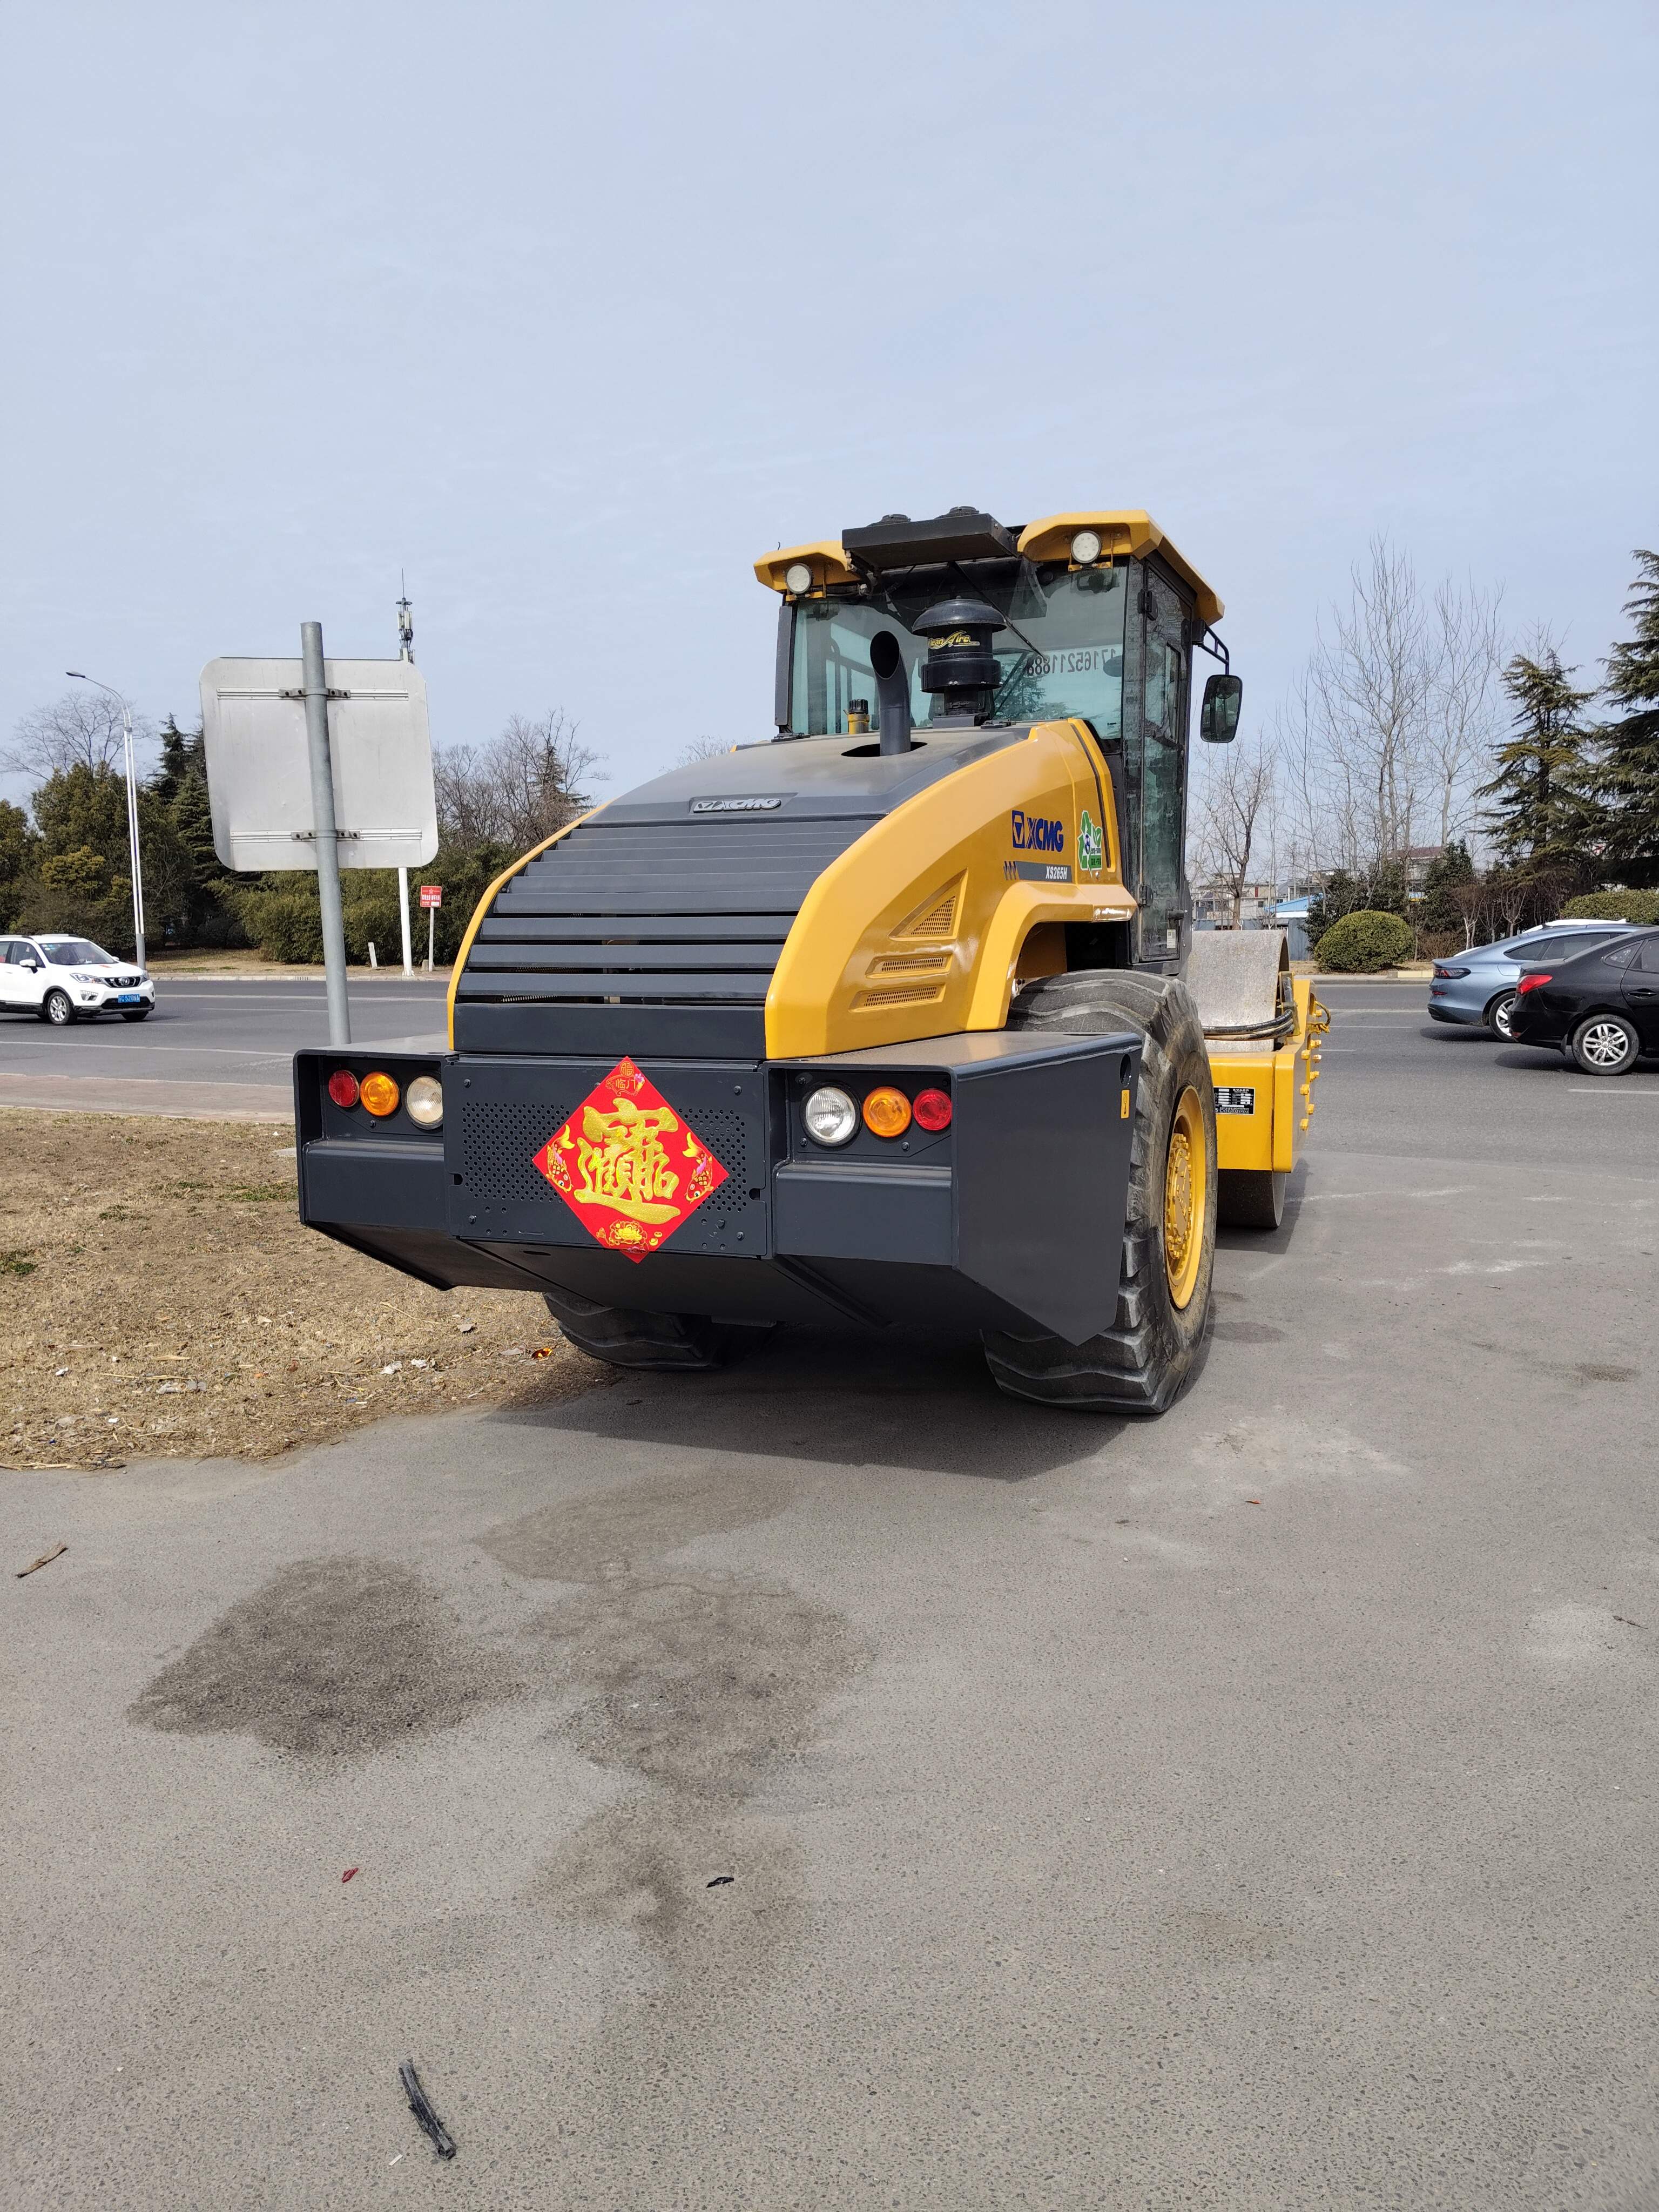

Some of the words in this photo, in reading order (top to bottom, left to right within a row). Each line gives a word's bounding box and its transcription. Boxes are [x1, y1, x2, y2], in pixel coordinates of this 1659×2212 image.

[1025, 817, 1064, 853] XCMG
[1045, 866, 1068, 880] XS265H
[620, 1062, 634, 1077] 福
